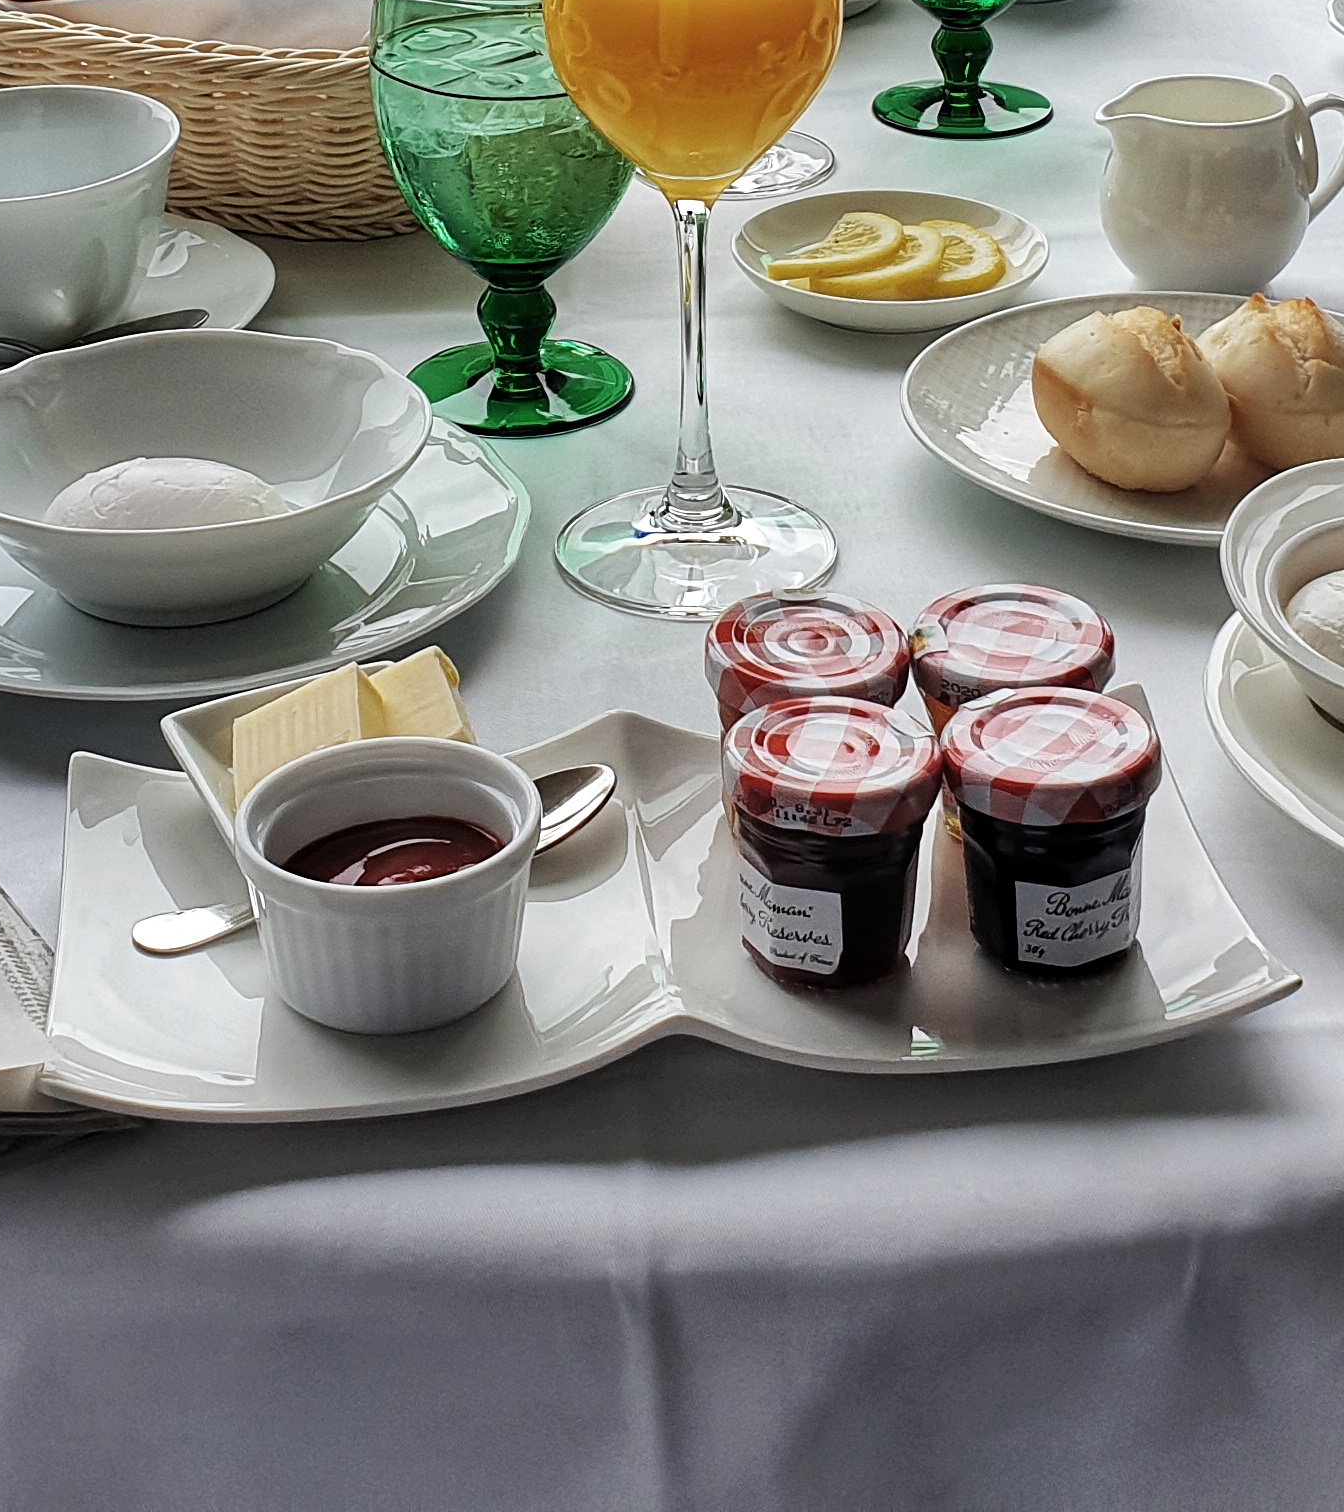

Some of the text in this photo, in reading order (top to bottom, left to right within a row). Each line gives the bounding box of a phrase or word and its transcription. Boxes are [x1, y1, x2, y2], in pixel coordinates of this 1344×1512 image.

[941, 678, 981, 698] 2020
[1045, 891, 1100, 917] Bonne
[1023, 919, 1060, 940] Red
